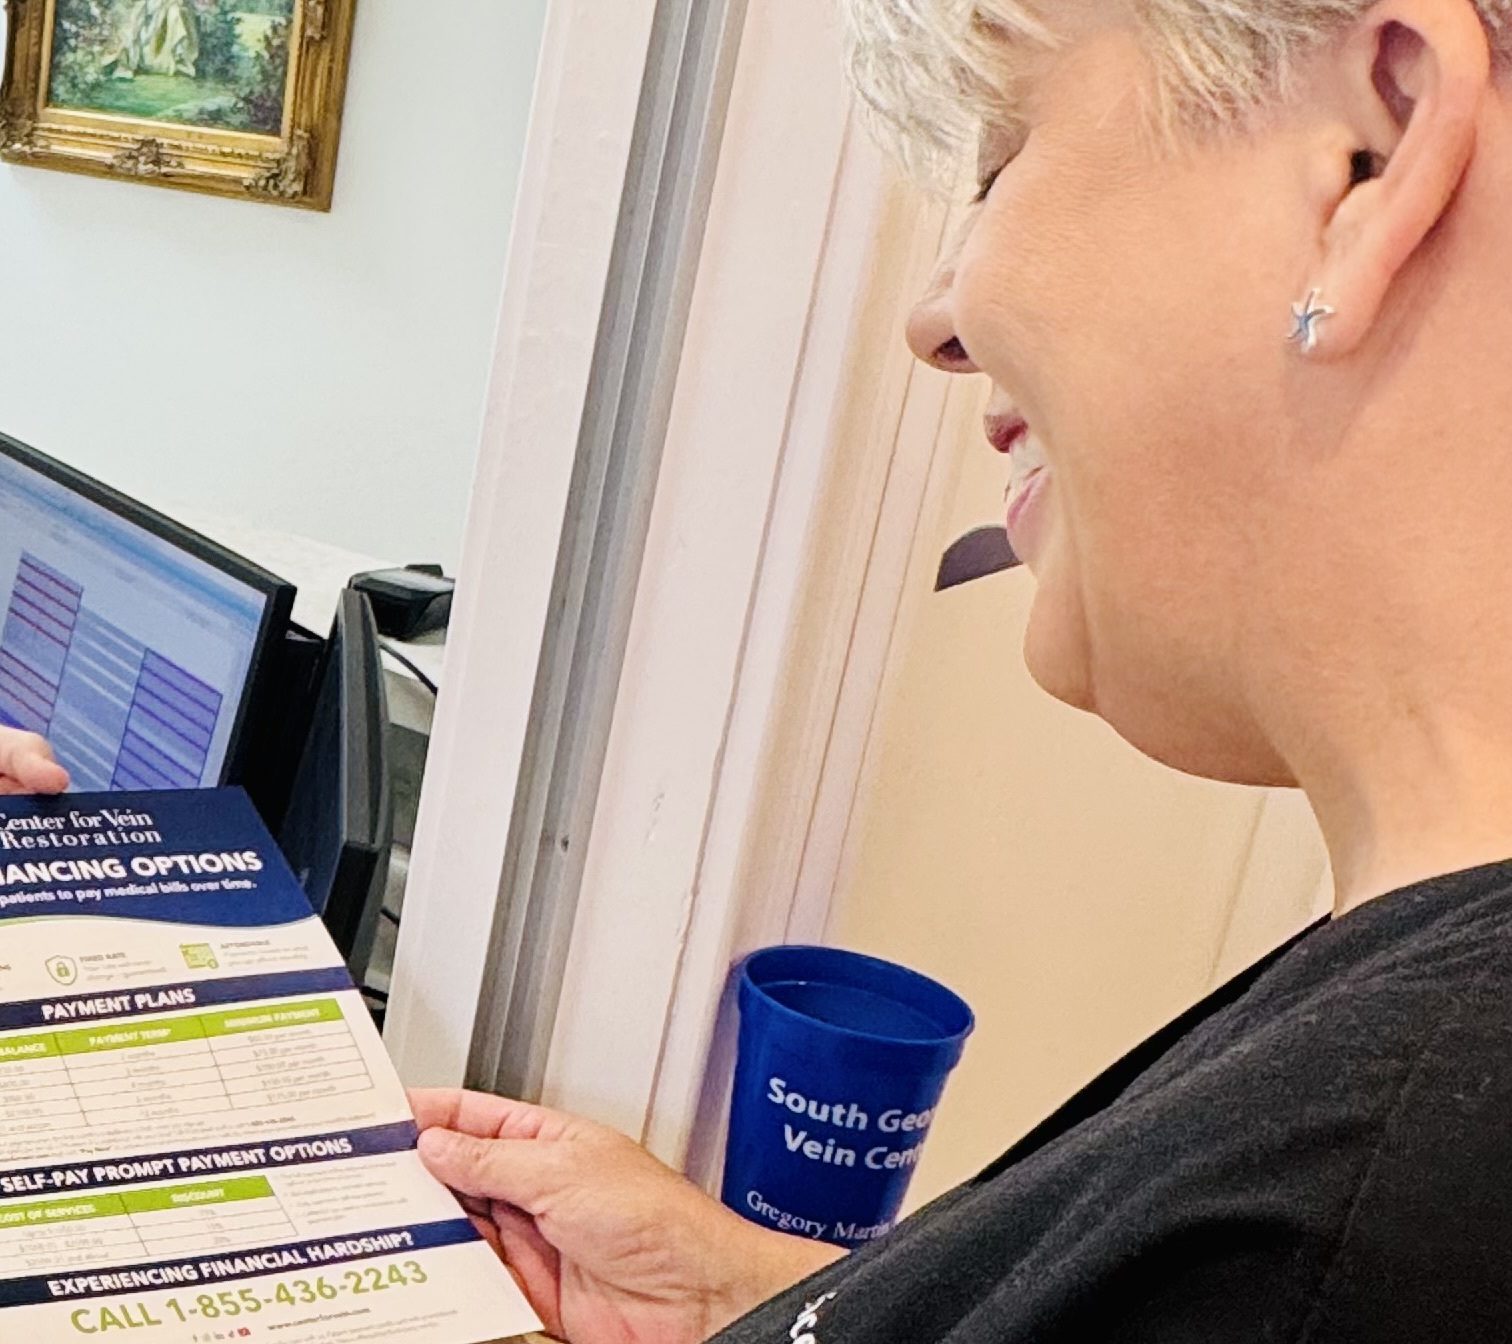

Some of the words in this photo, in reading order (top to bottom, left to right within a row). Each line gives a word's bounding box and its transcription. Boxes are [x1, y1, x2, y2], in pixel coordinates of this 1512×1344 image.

[69, 810, 103, 829] for
[99, 808, 154, 828] Vein
[130, 850, 264, 877] OPTIONS
[57, 889, 73, 901] to
[76, 886, 102, 902] pay
[103, 881, 159, 897] medical
[42, 991, 133, 1022] PAYMENT
[135, 987, 196, 1010] PLANS
[767, 1076, 868, 1132] South
[0, 1168, 89, 1193] SELF-PAY
[92, 1158, 175, 1182] PROMPT
[177, 1148, 267, 1172] PAYMENT
[269, 1137, 353, 1162] OPTIONS
[783, 1124, 856, 1167] Vein
[747, 1190, 827, 1239] Gregory
[47, 1264, 199, 1297] EXPERIENCING
[199, 1251, 307, 1278] FINANCIAL
[308, 1233, 414, 1262] HARDSHIP?
[70, 1301, 162, 1335] CALL
[166, 1259, 429, 1324] 1-855-436-2243
